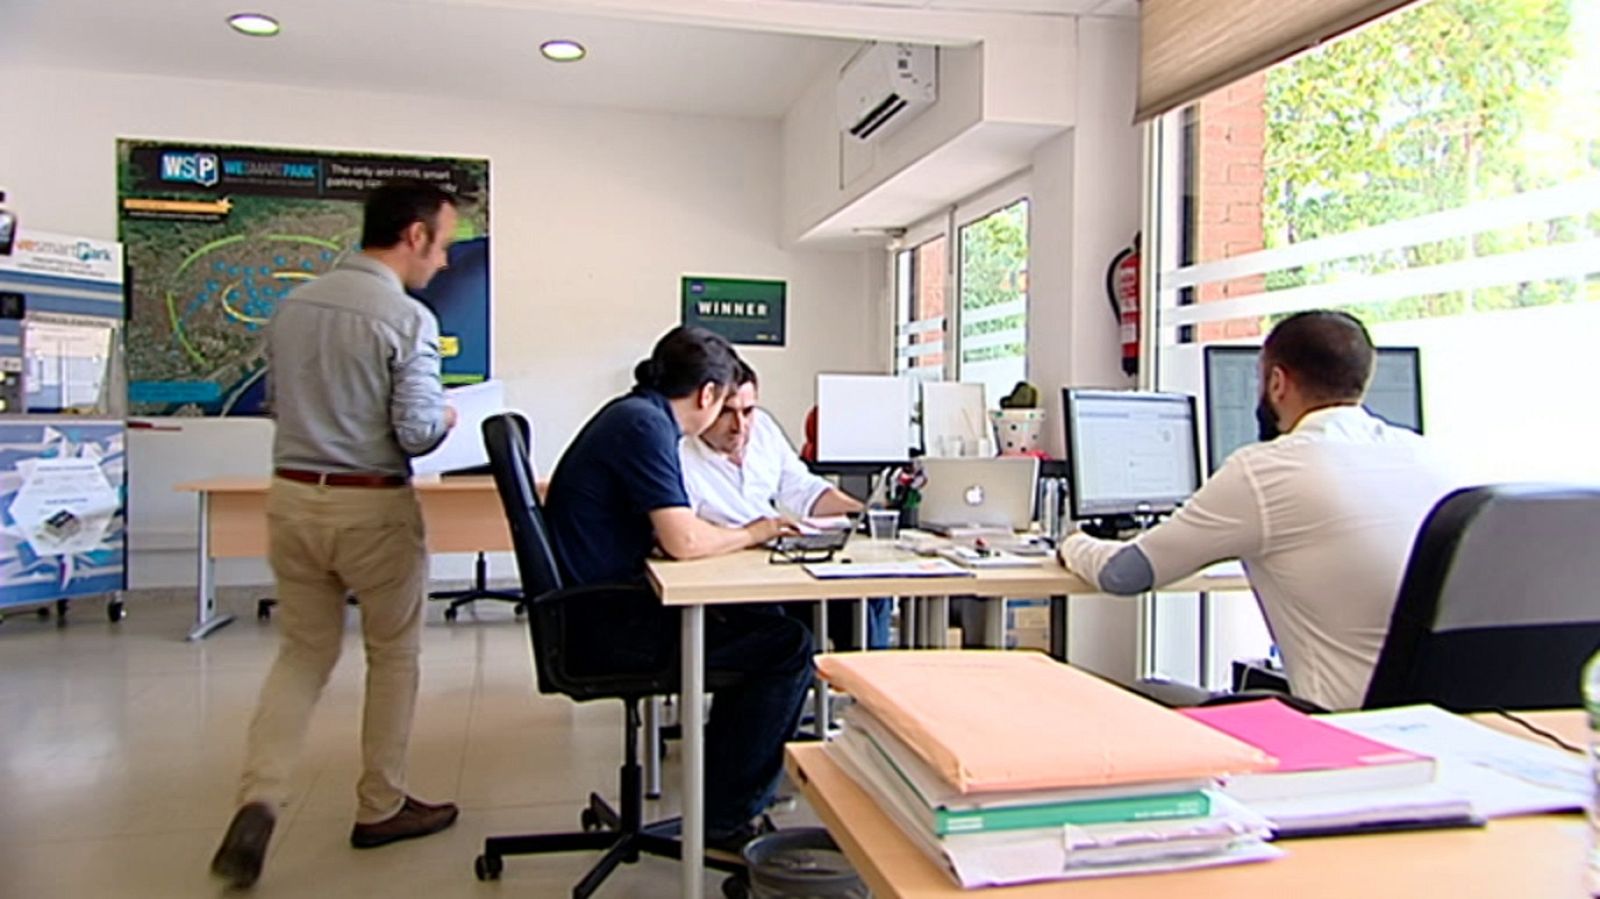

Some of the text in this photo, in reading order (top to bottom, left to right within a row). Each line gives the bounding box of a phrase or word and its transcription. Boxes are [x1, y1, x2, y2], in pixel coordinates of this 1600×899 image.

[162, 153, 215, 180] WSP
[331, 162, 350, 174] The
[325, 177, 364, 190] parking
[697, 300, 768, 316] WINNER
